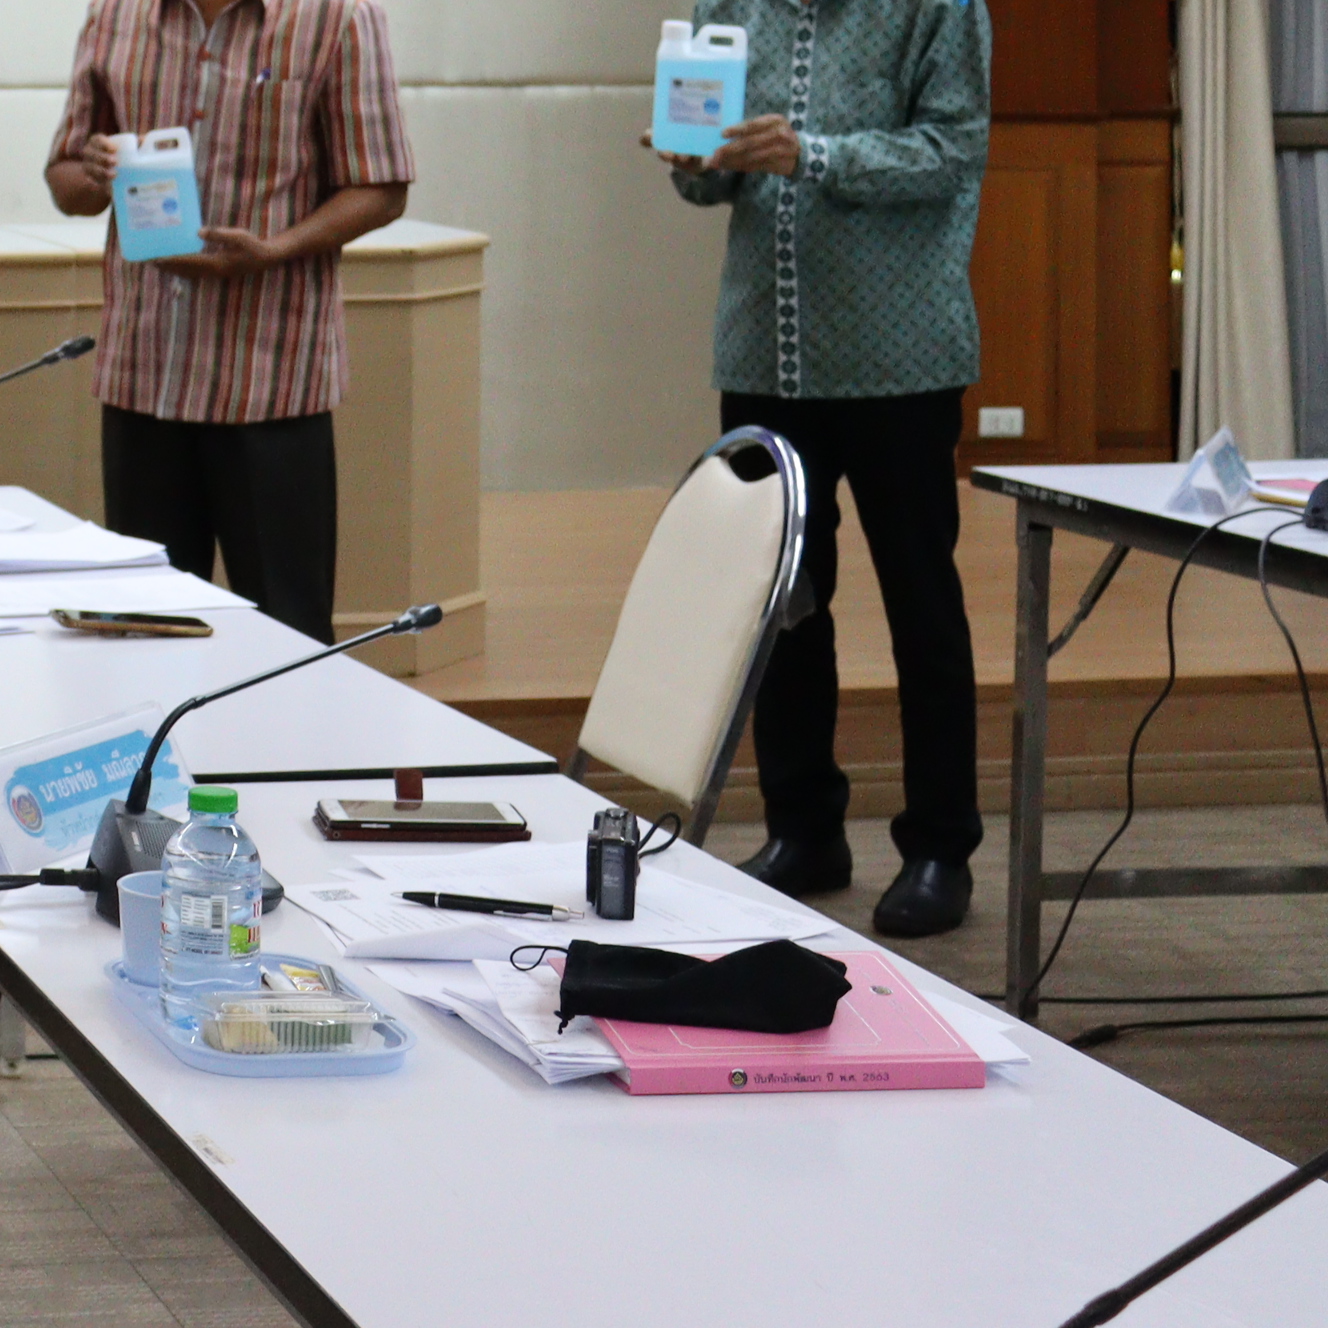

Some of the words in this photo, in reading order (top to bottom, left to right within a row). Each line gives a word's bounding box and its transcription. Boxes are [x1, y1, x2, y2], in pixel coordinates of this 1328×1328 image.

[38, 761, 98, 803] นายพิชัย
[862, 1073, 890, 1082] 2563
